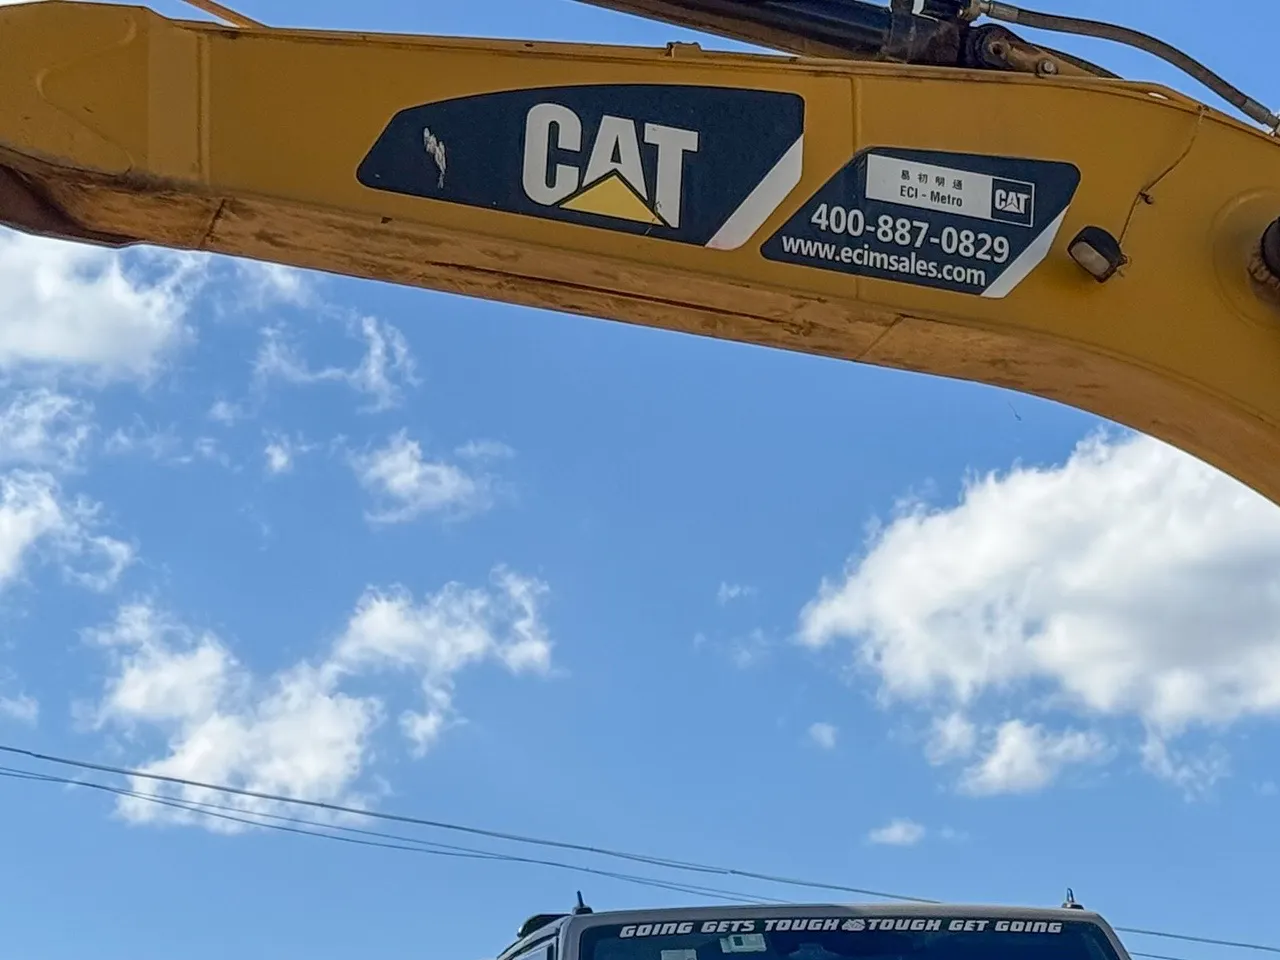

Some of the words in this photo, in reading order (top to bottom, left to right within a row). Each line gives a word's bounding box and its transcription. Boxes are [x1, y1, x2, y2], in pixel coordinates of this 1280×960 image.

[522, 102, 700, 230] CAT
[900, 169, 964, 191] 易初明通
[900, 185, 919, 200] ECI
[930, 191, 963, 207] Metro
[994, 188, 1030, 215] CAT
[810, 203, 1011, 264] 400-887-0829
[782, 235, 986, 287] www.ecimsales.com
[619, 921, 695, 938] GOING
[701, 920, 756, 933] GETS
[764, 919, 840, 932] TOUGH
[868, 918, 942, 931] TOUGH
[949, 919, 989, 932] GET
[994, 921, 1063, 933] GOING
